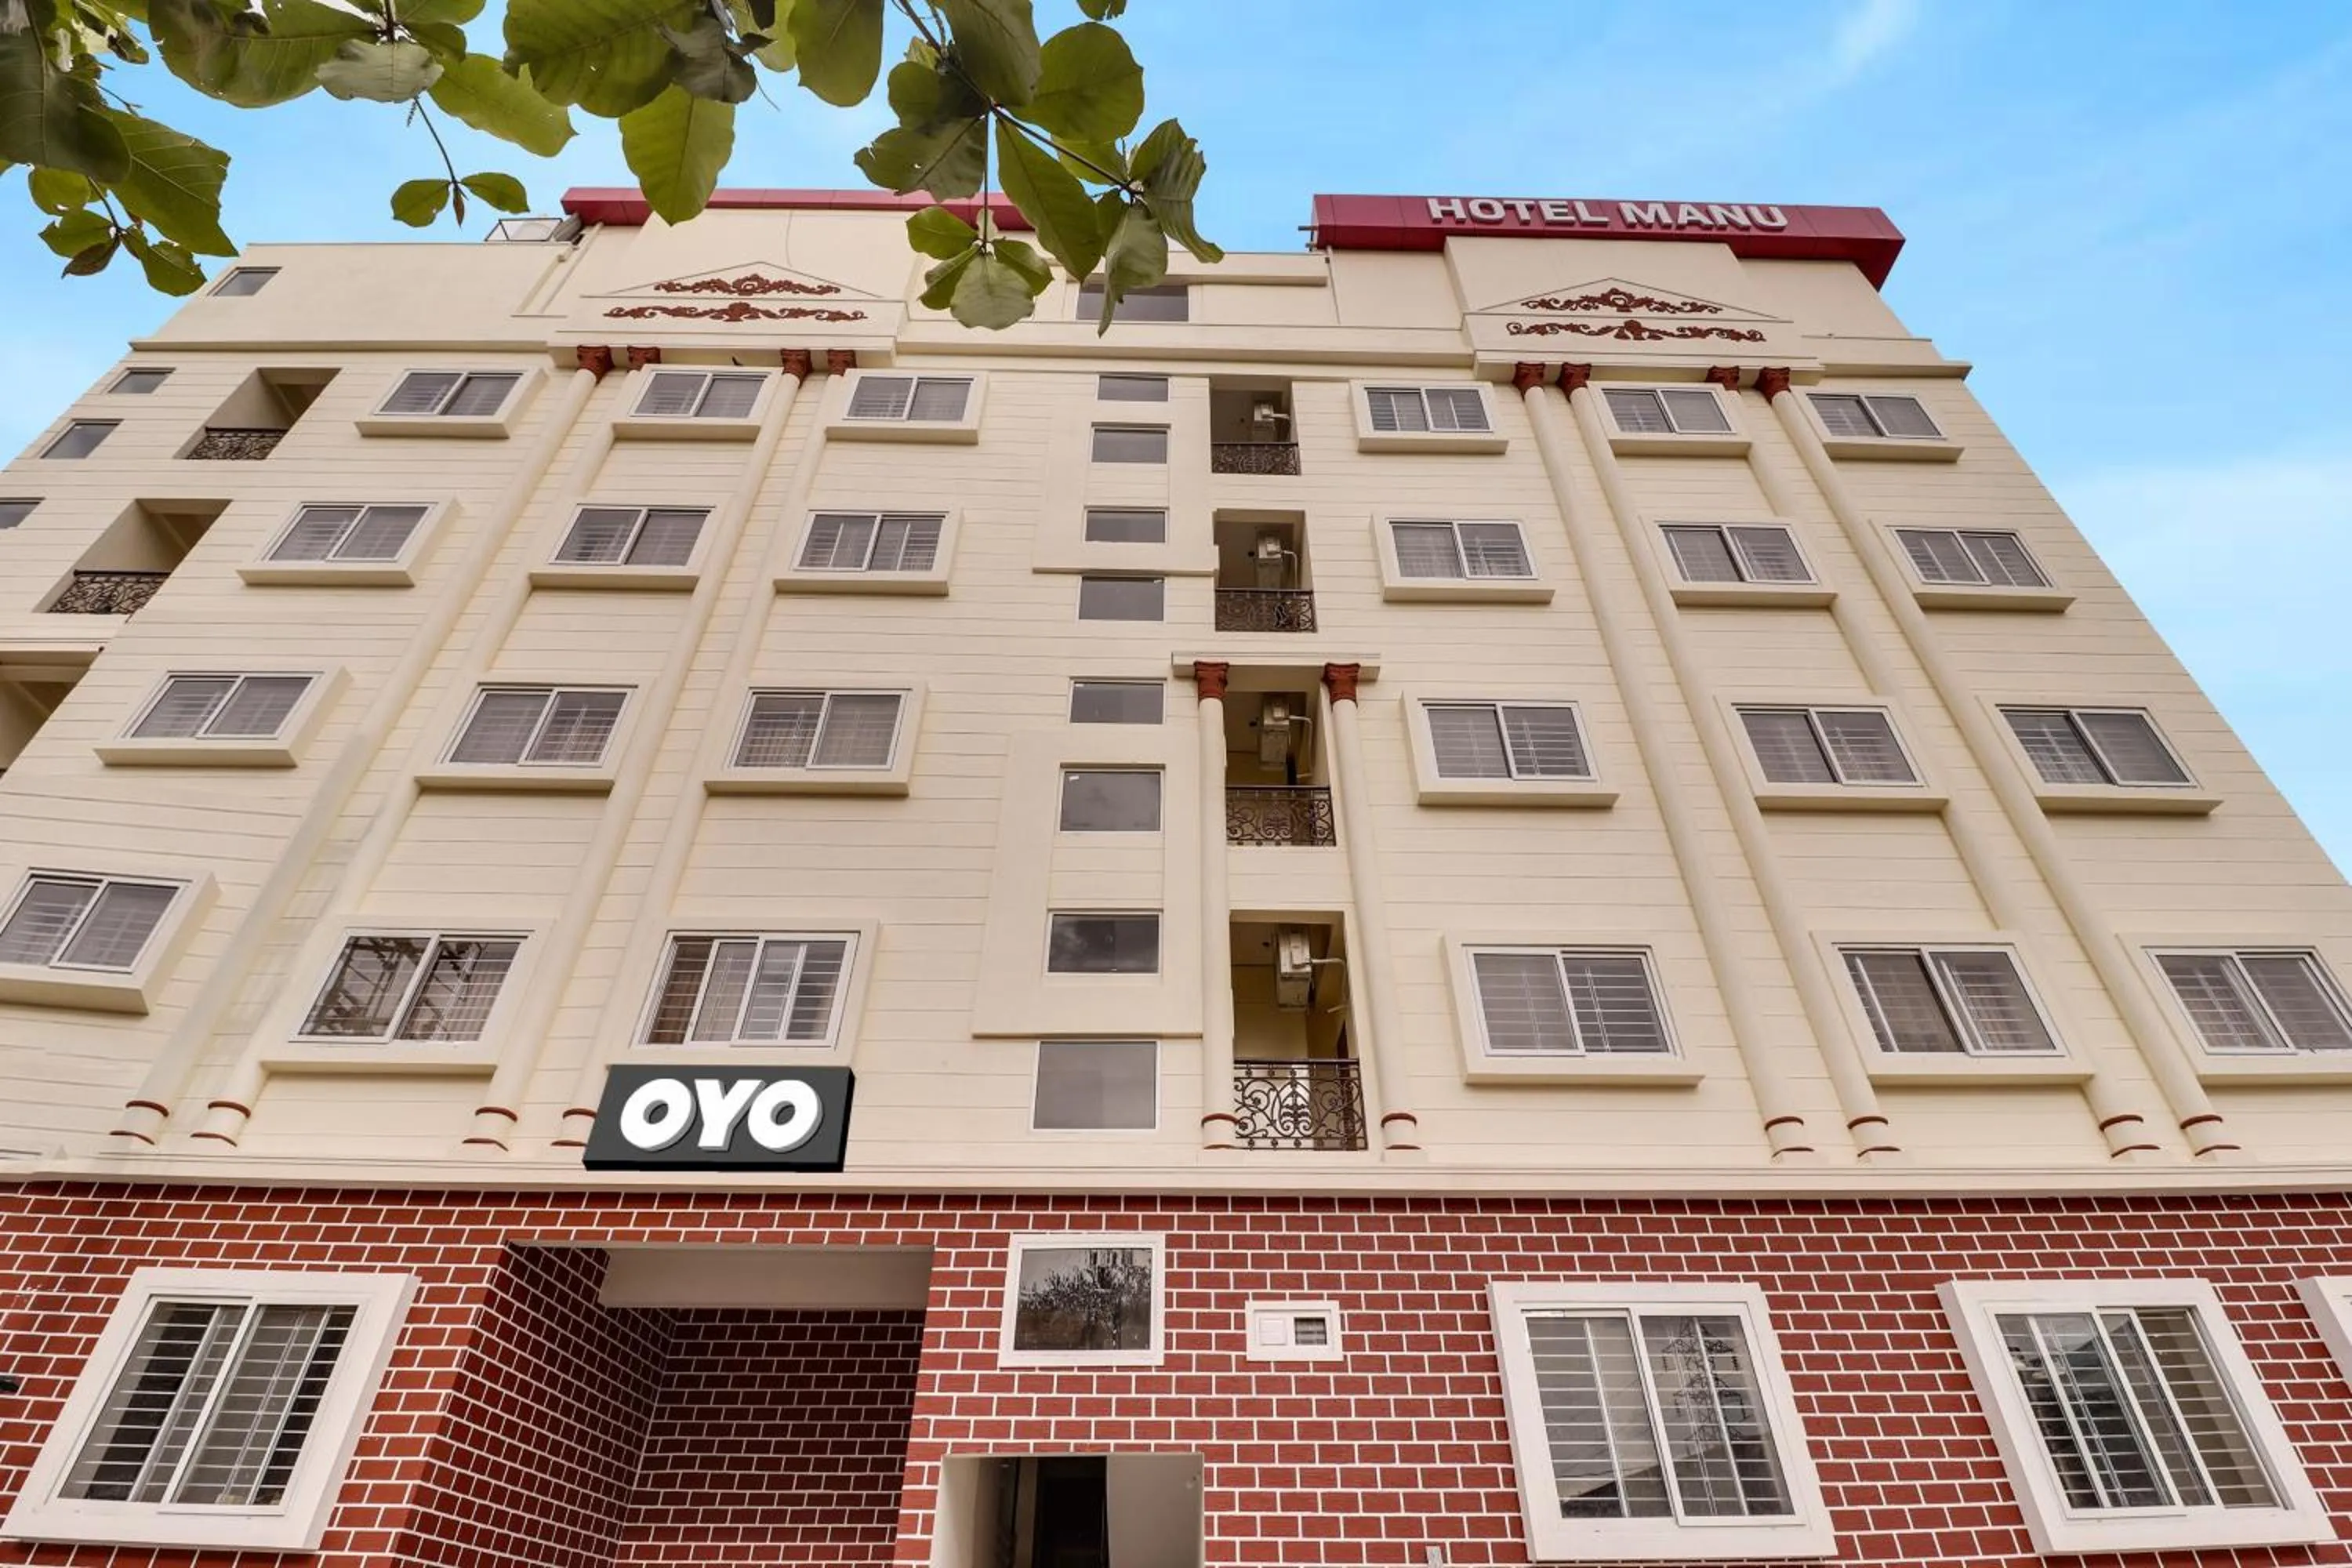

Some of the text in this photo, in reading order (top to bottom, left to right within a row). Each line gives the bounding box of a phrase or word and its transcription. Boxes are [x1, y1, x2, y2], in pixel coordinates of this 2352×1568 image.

[1427, 198, 1788, 230] HOTEL MANU
[620, 1078, 822, 1152] OYO
